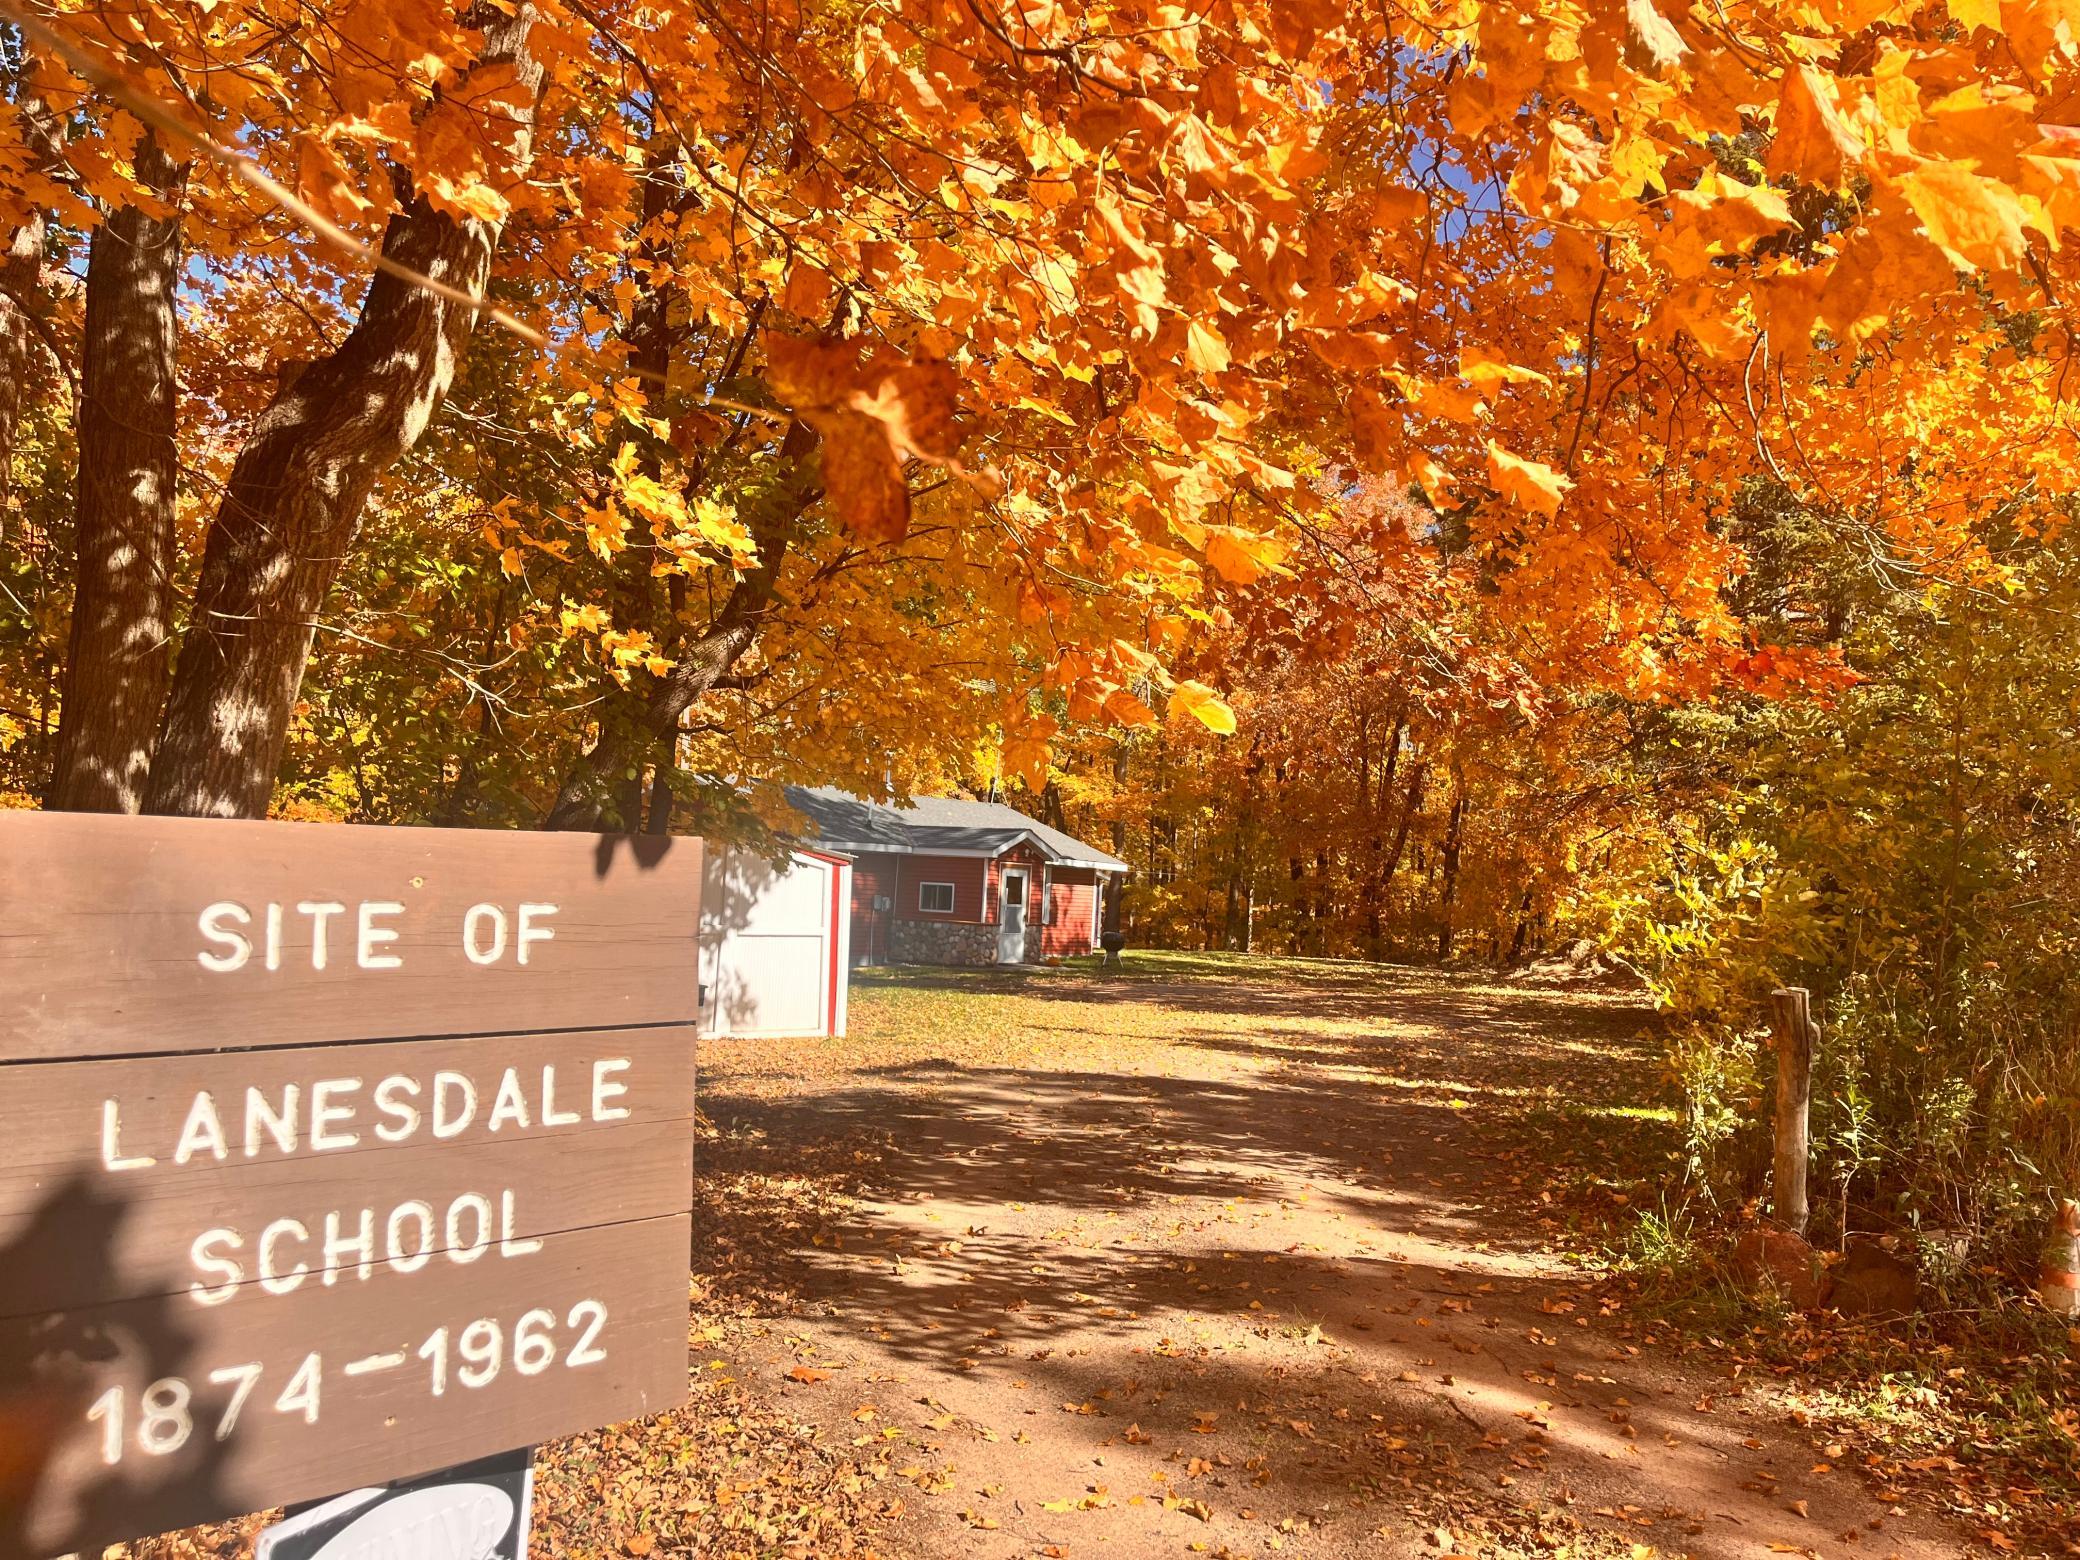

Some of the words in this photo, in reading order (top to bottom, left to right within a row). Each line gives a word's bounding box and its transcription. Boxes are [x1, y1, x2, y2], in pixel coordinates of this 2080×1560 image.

[199, 901, 406, 972] SITE
[462, 902, 560, 966] OF
[103, 1058, 632, 1171] LANESDALE
[190, 1189, 544, 1306] SCHOOL
